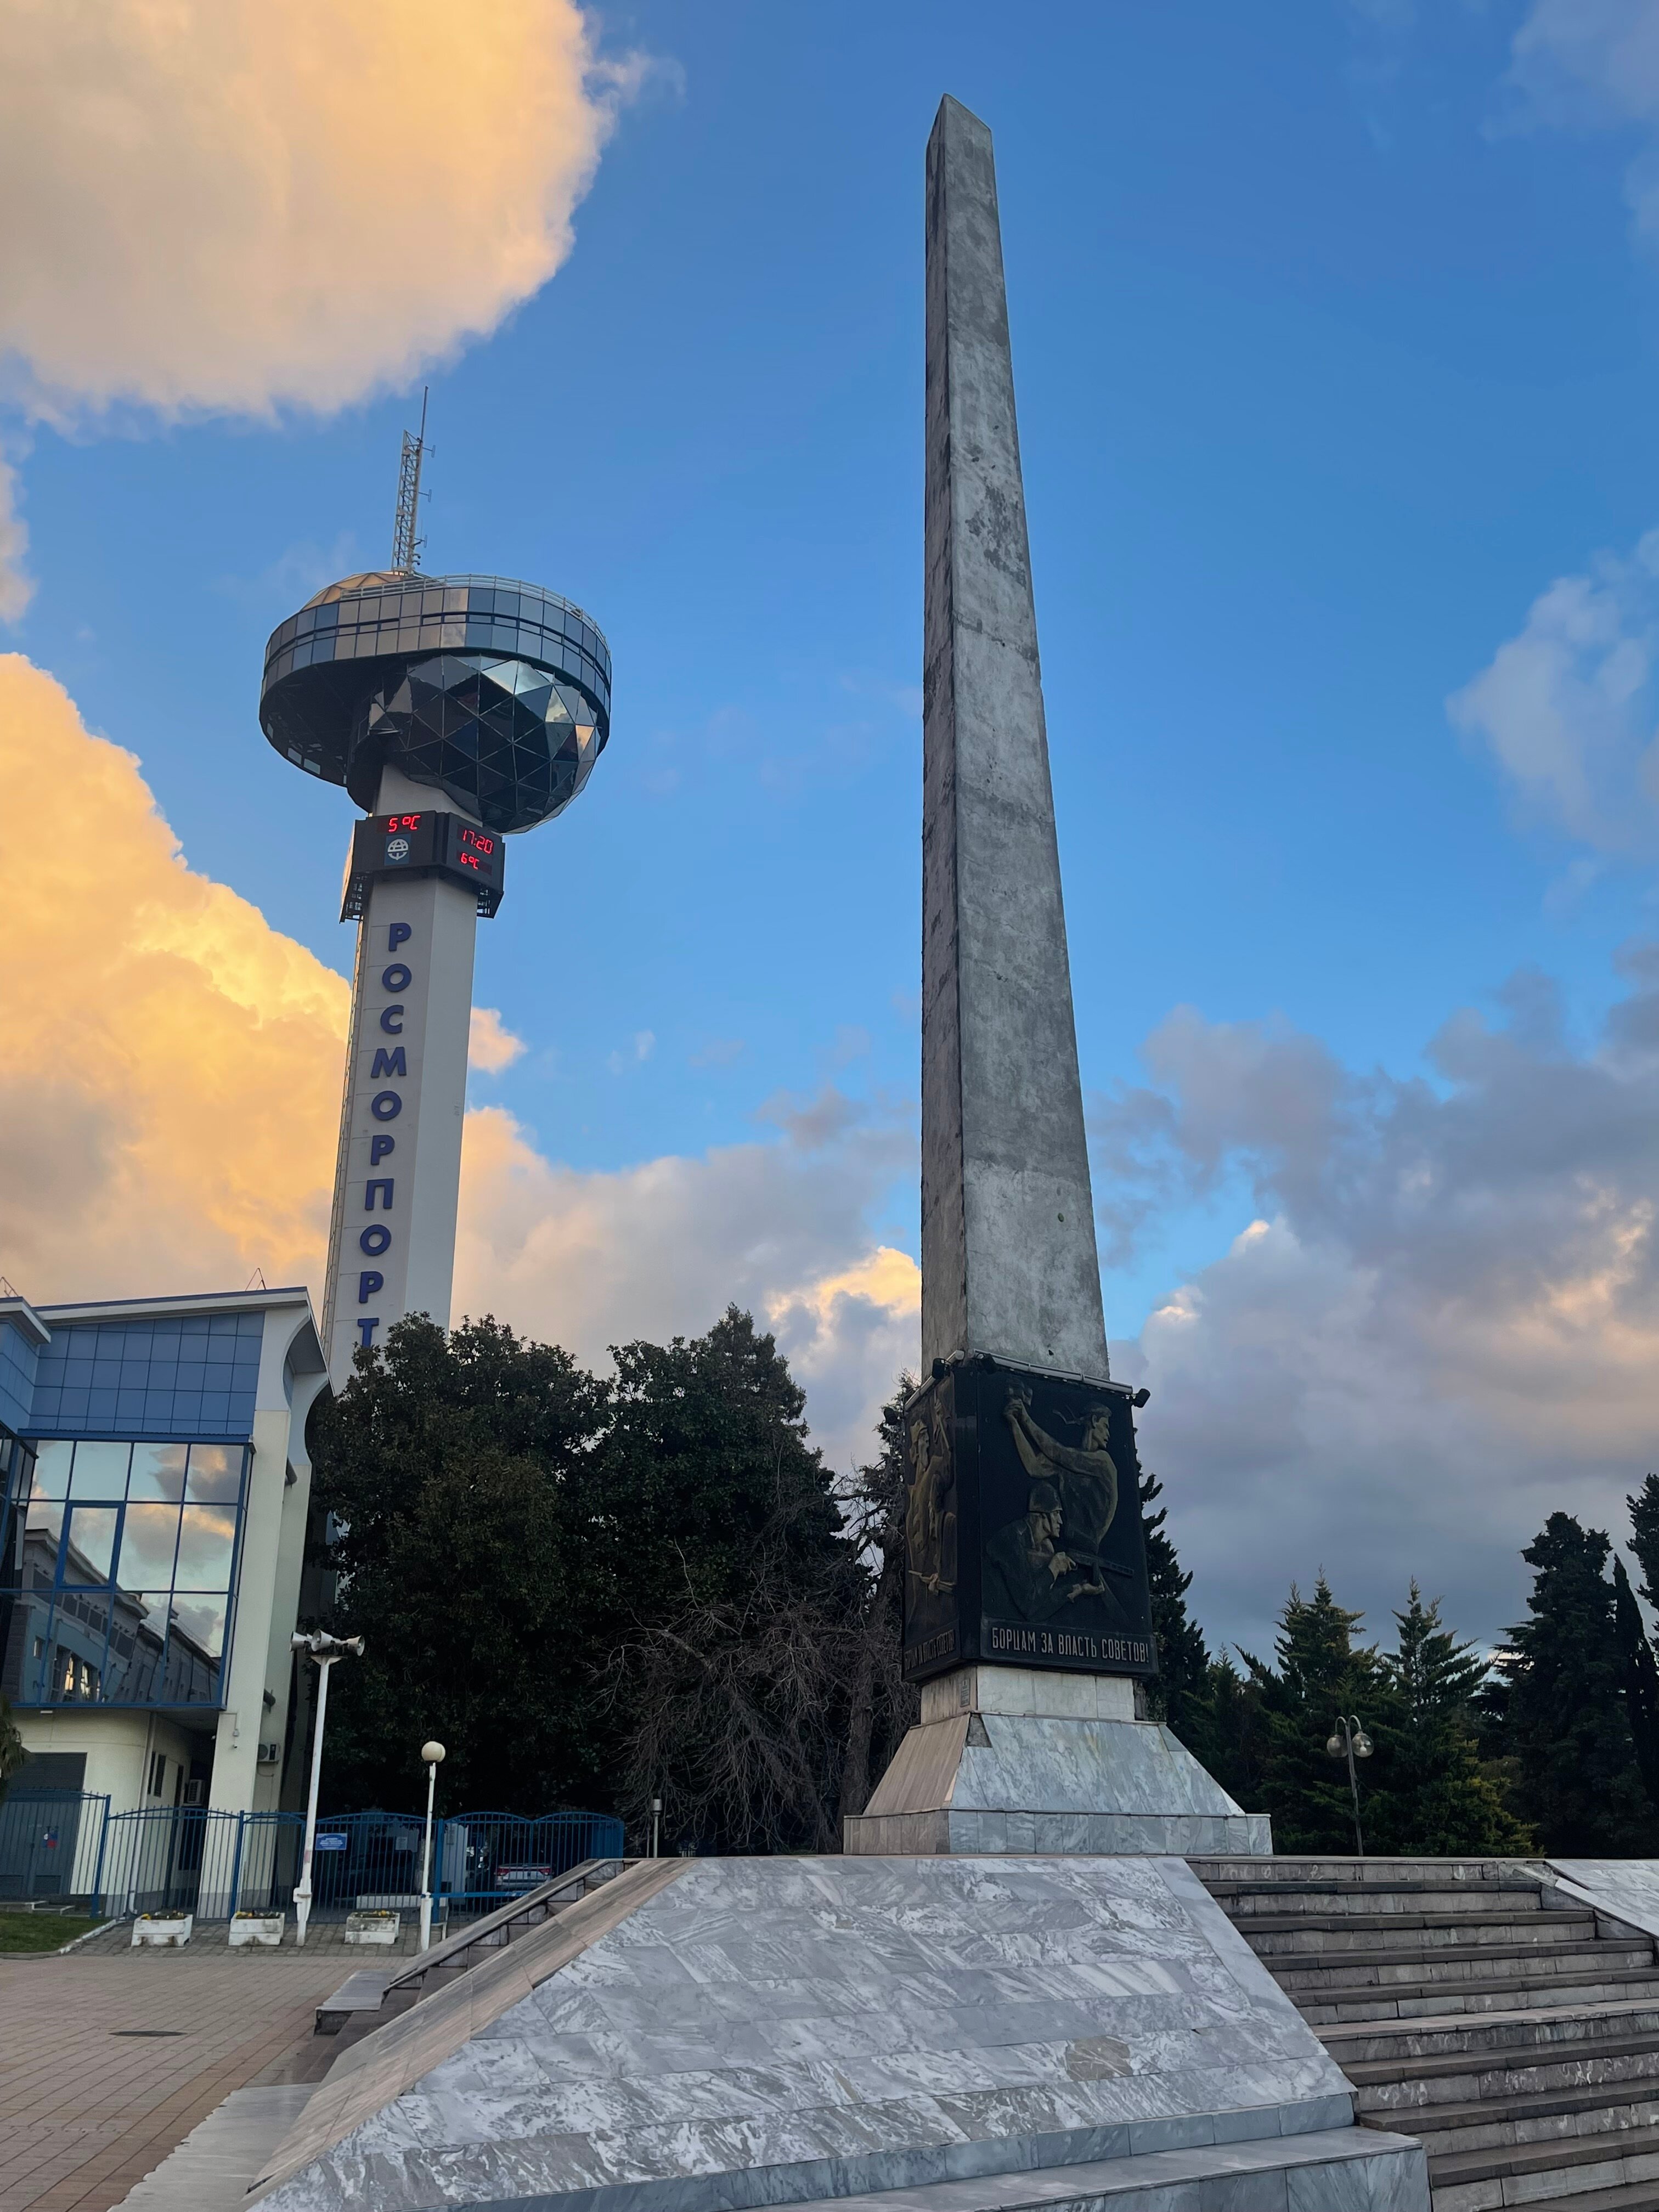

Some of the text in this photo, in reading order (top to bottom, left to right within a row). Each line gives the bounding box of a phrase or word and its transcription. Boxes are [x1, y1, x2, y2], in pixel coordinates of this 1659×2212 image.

[462, 829, 493, 854] 17:20
[357, 922, 412, 1348] РОСМОРПОРТ
[992, 1627, 1149, 1663] БОРЦАМ ЗА ВЛАСТЬ СОВЕТОВ!
